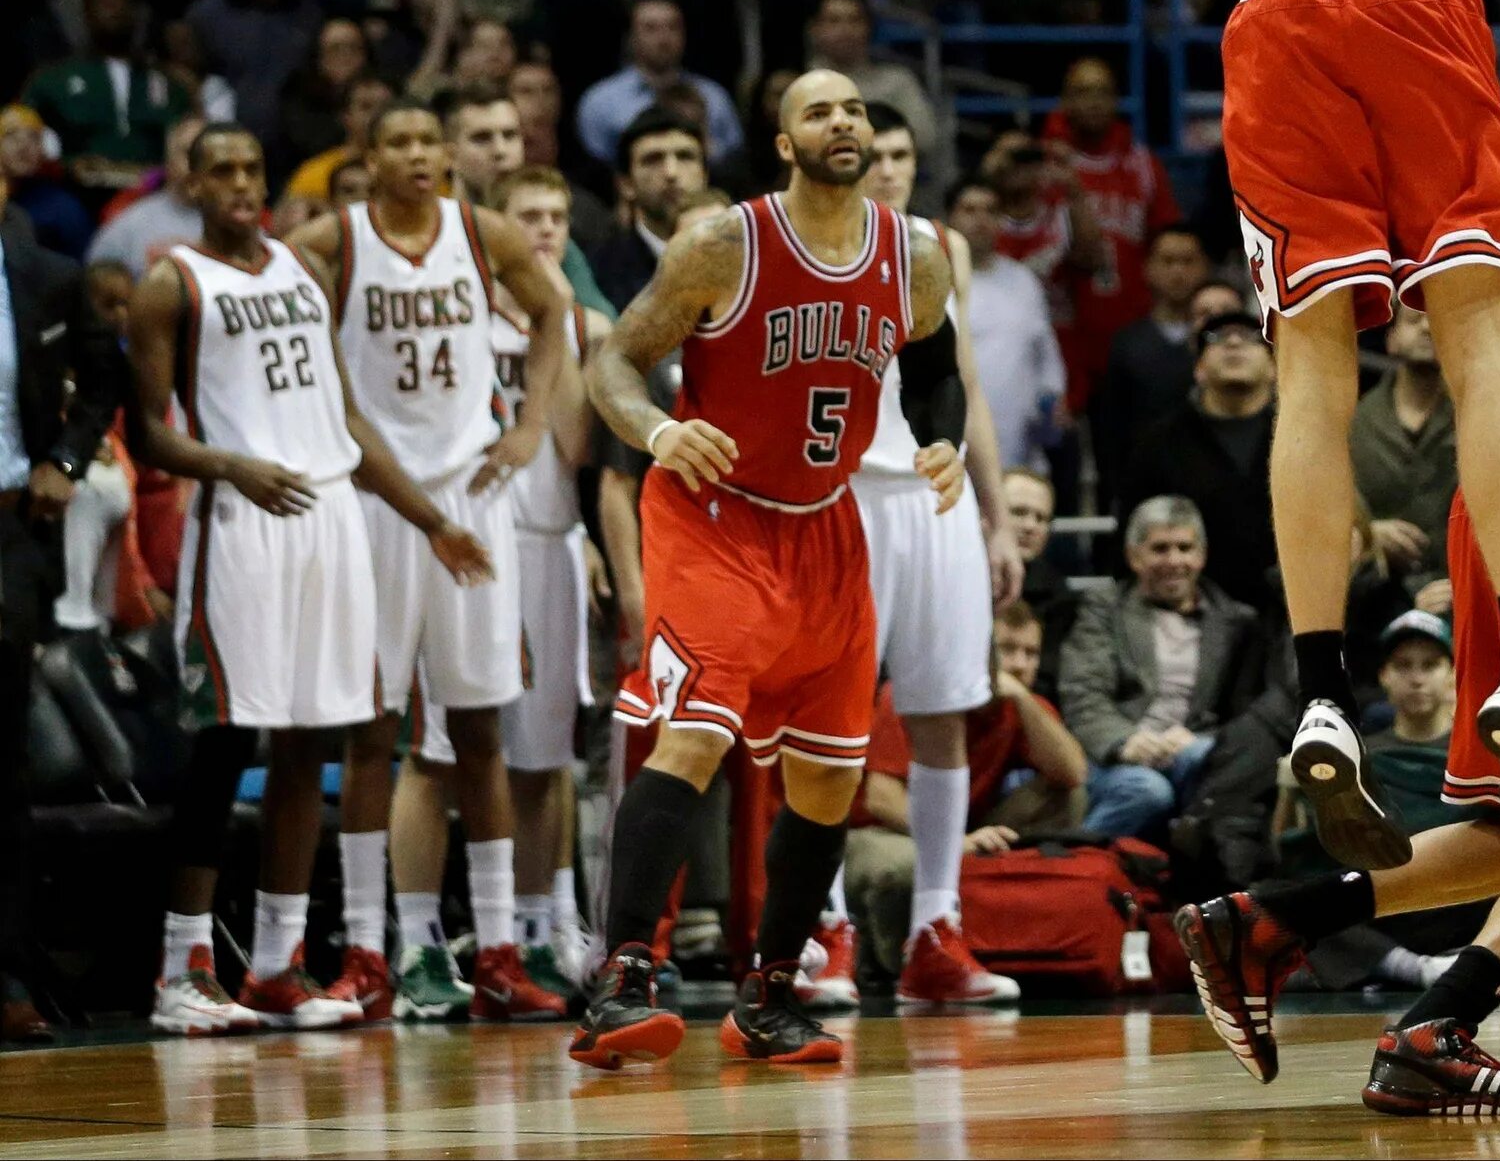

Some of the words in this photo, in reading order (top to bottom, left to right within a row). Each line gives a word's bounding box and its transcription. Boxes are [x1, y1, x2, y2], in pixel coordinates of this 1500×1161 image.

[214, 284, 322, 336] BUCKS
[365, 278, 474, 333] BUCKS
[259, 335, 316, 392] 22
[395, 336, 459, 392] 34
[761, 301, 897, 385] BULLS
[803, 386, 851, 467] 5
